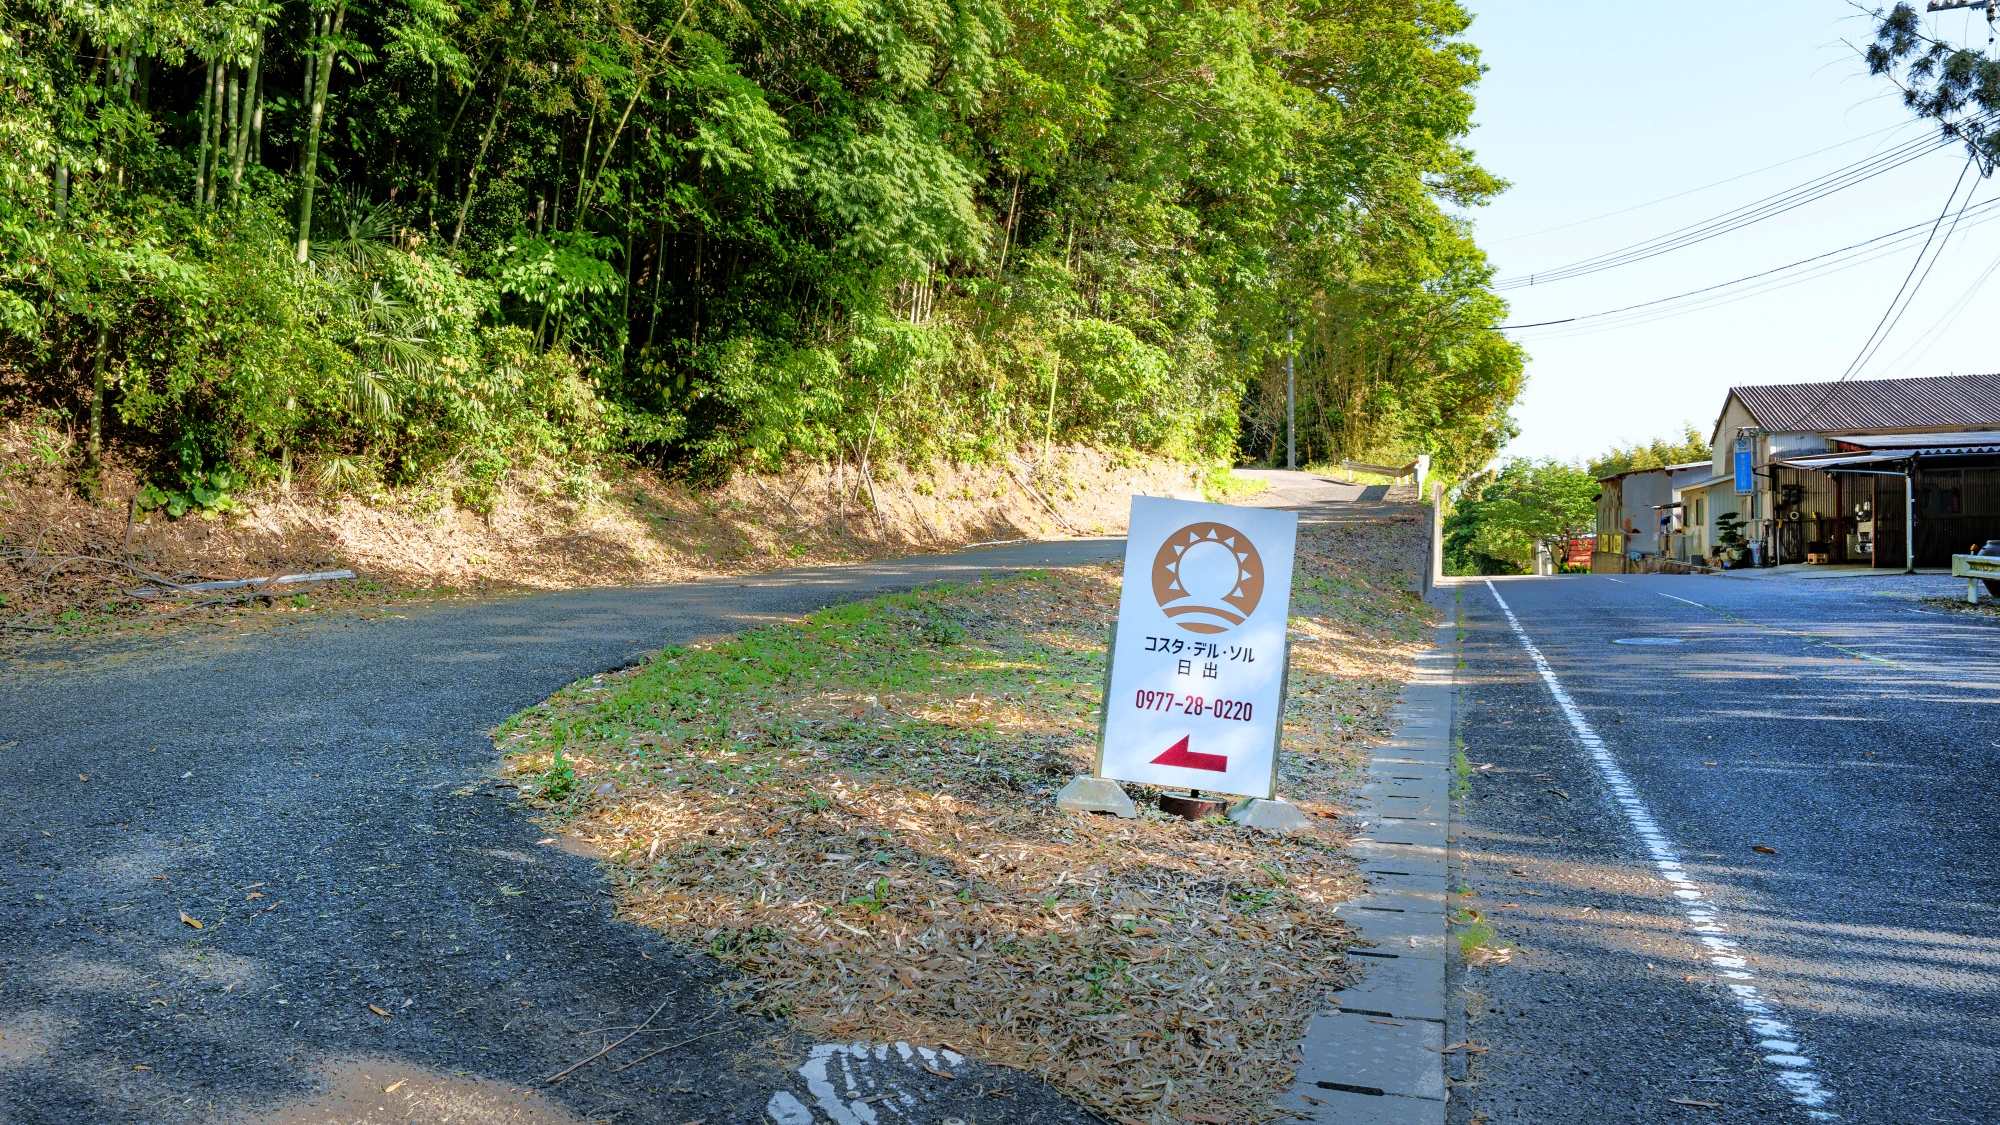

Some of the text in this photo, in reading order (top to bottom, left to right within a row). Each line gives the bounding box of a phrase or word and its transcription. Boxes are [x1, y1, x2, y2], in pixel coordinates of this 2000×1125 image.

[1145, 636, 1255, 663] コスタ・デル・ソル
[1136, 689, 1253, 721] 0977-28-0220
